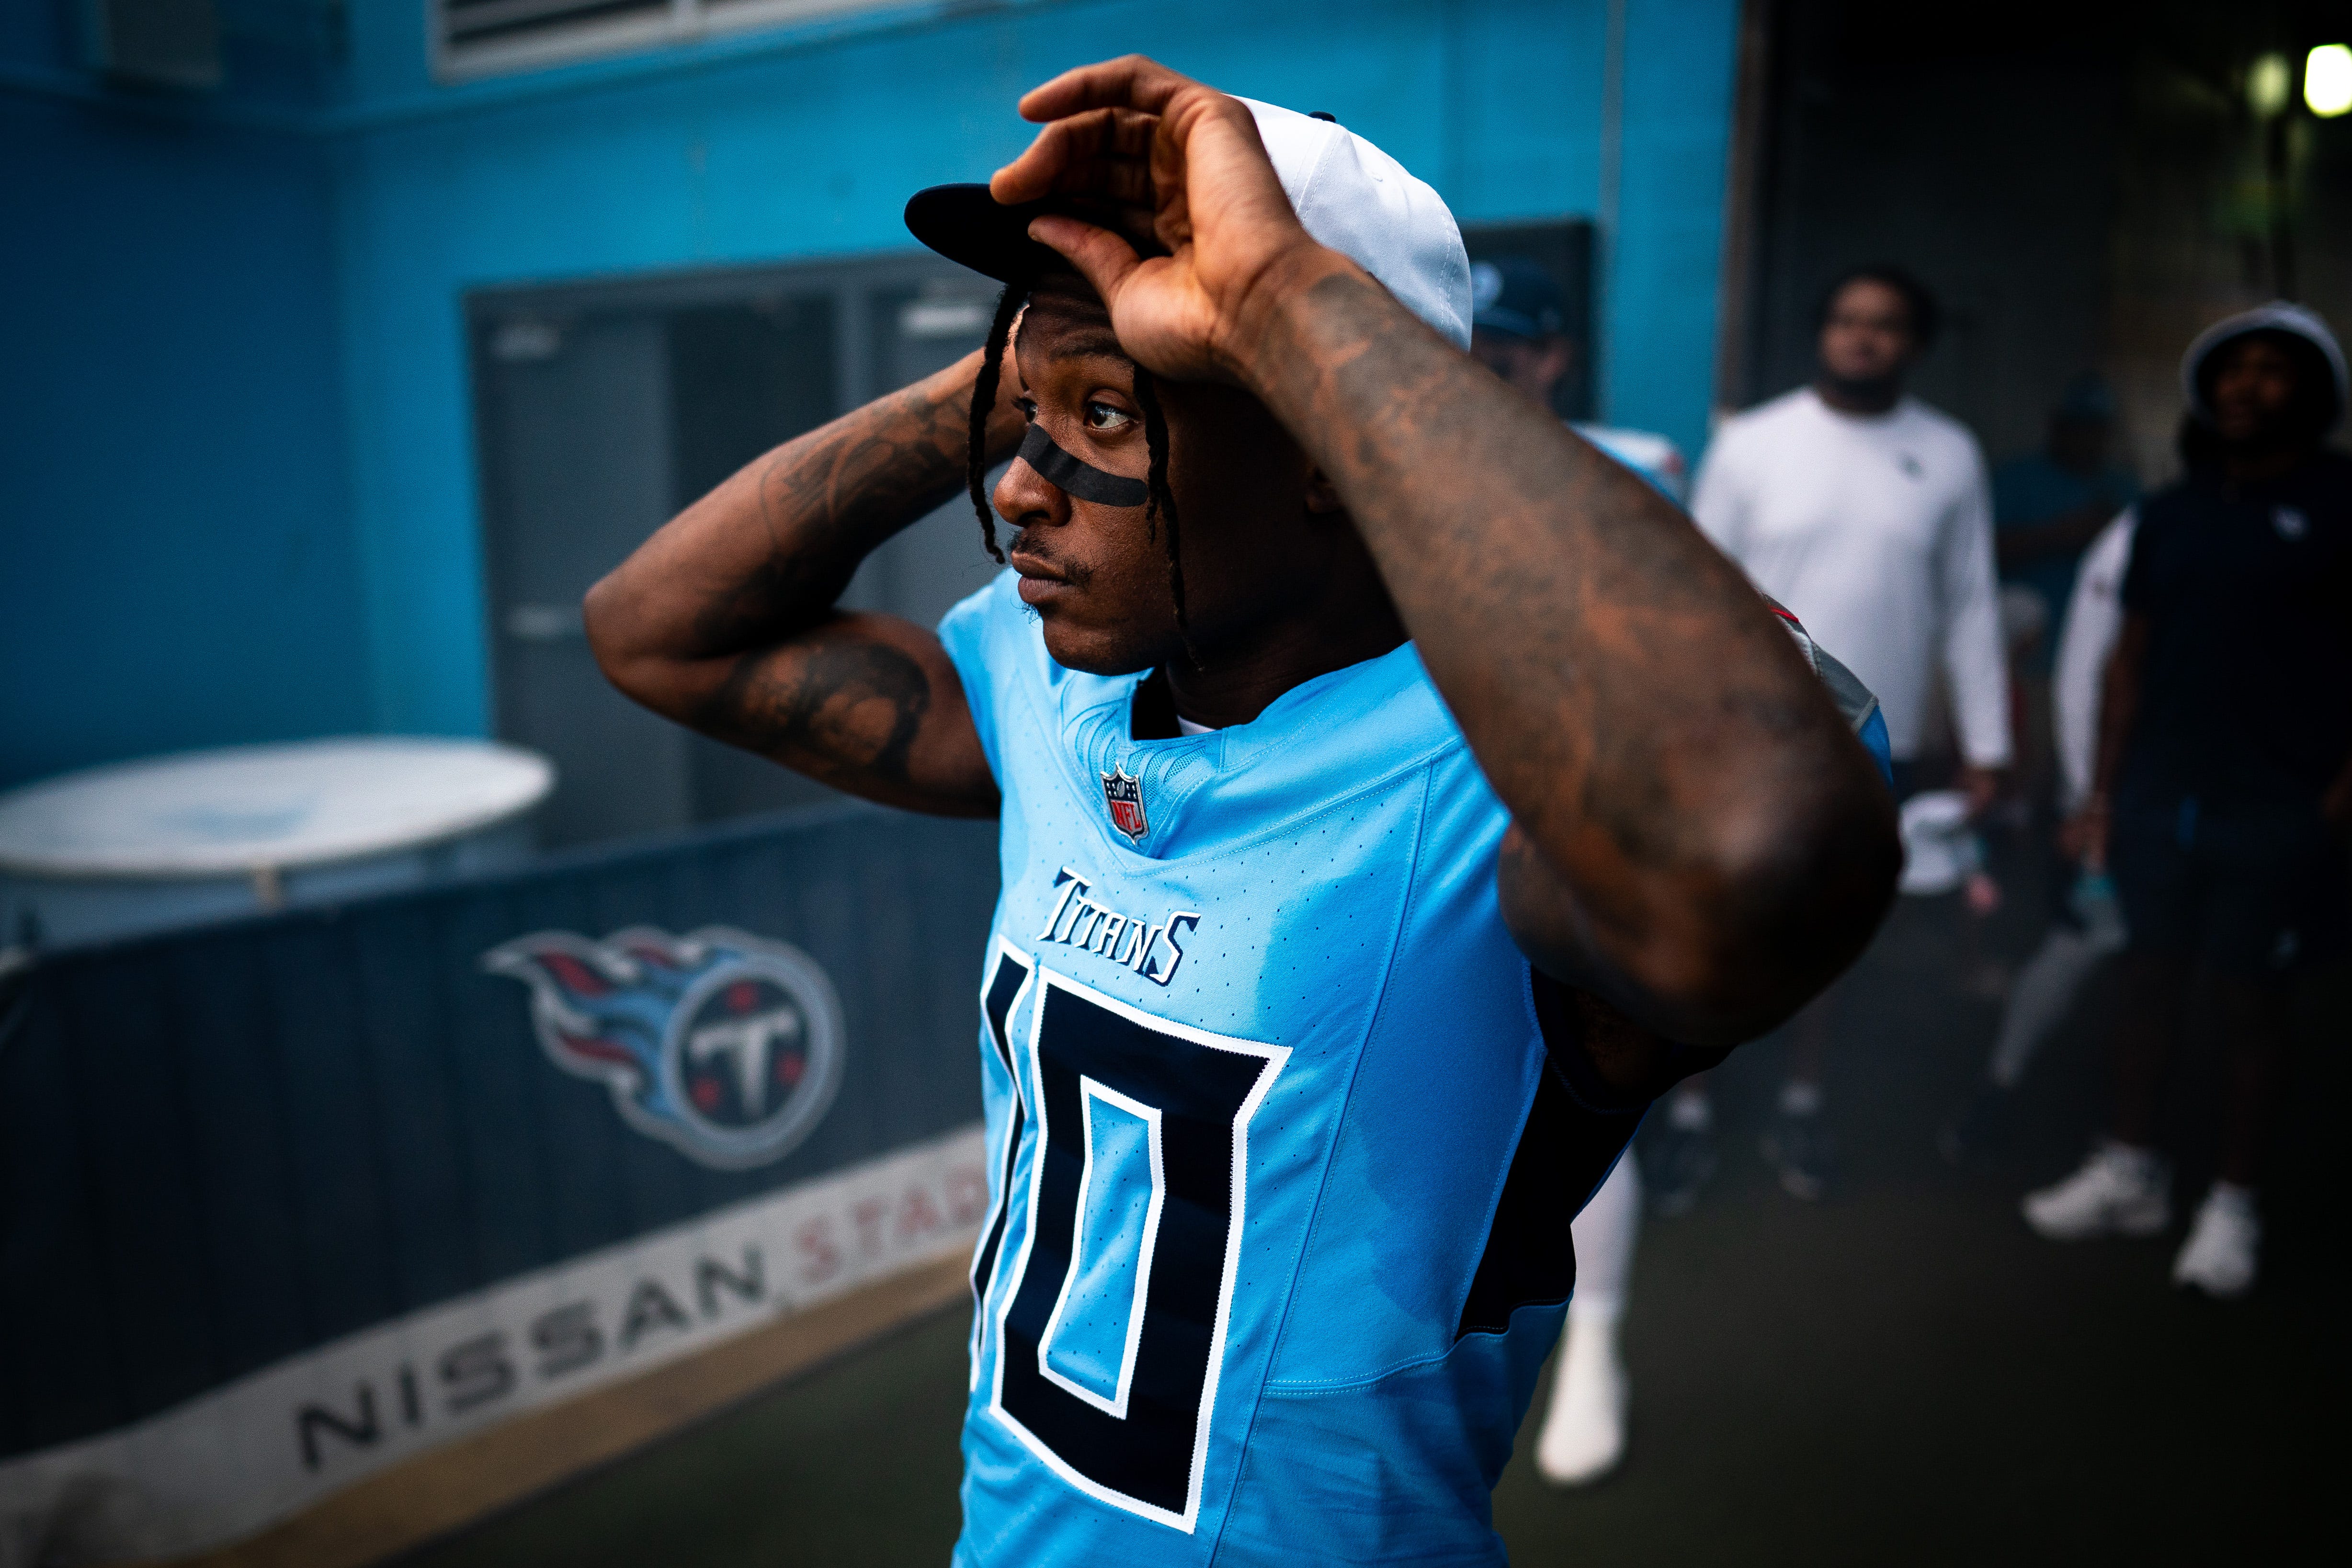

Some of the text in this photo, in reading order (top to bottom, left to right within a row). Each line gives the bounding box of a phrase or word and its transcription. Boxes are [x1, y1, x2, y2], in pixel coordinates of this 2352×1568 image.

[1111, 800, 1142, 831] NFL
[687, 1003, 800, 1121] T
[969, 933, 1294, 1535] 10
[293, 1240, 770, 1473] NISSAN
